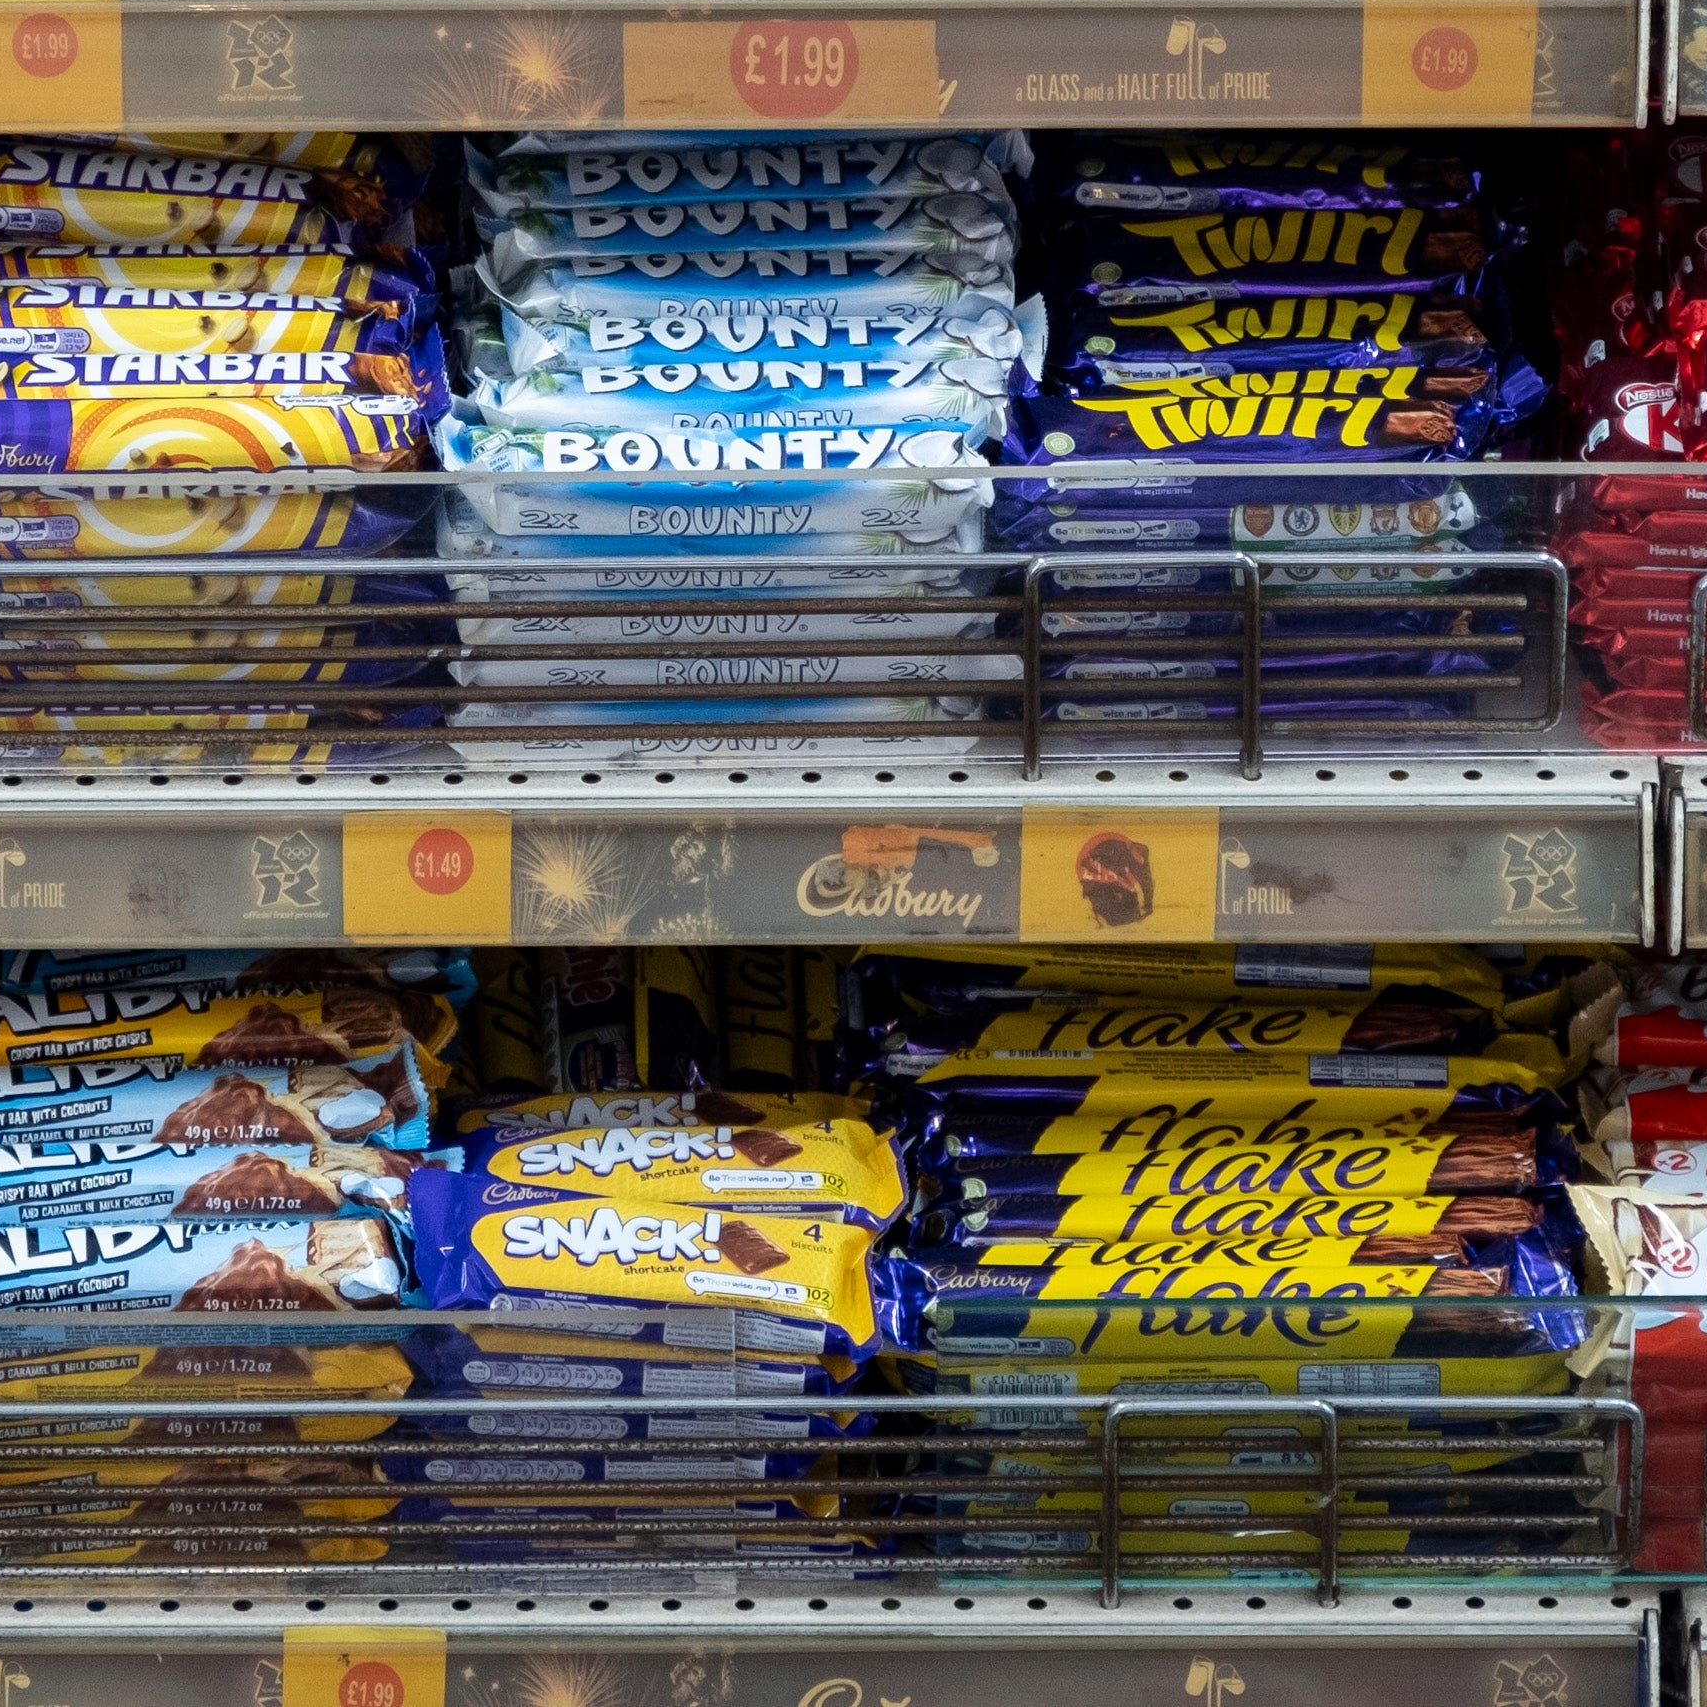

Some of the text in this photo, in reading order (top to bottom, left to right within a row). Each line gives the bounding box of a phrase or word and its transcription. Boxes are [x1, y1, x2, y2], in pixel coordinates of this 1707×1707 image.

[22, 32, 69, 61] £1.99
[745, 34, 844, 87] £1.99
[1421, 47, 1469, 75] £1.99
[27, 351, 354, 386] STARBAR
[543, 429, 895, 471] BOUNTY
[629, 505, 812, 536] BOUNTY
[414, 851, 461, 879] £1.49
[1122, 1144, 1390, 1193] flake
[506, 1209, 721, 1264] SNACK!
[804, 1224, 822, 1242] 4
[625, 1265, 685, 1275] shortcake
[928, 1266, 1033, 1293] Cadbury
